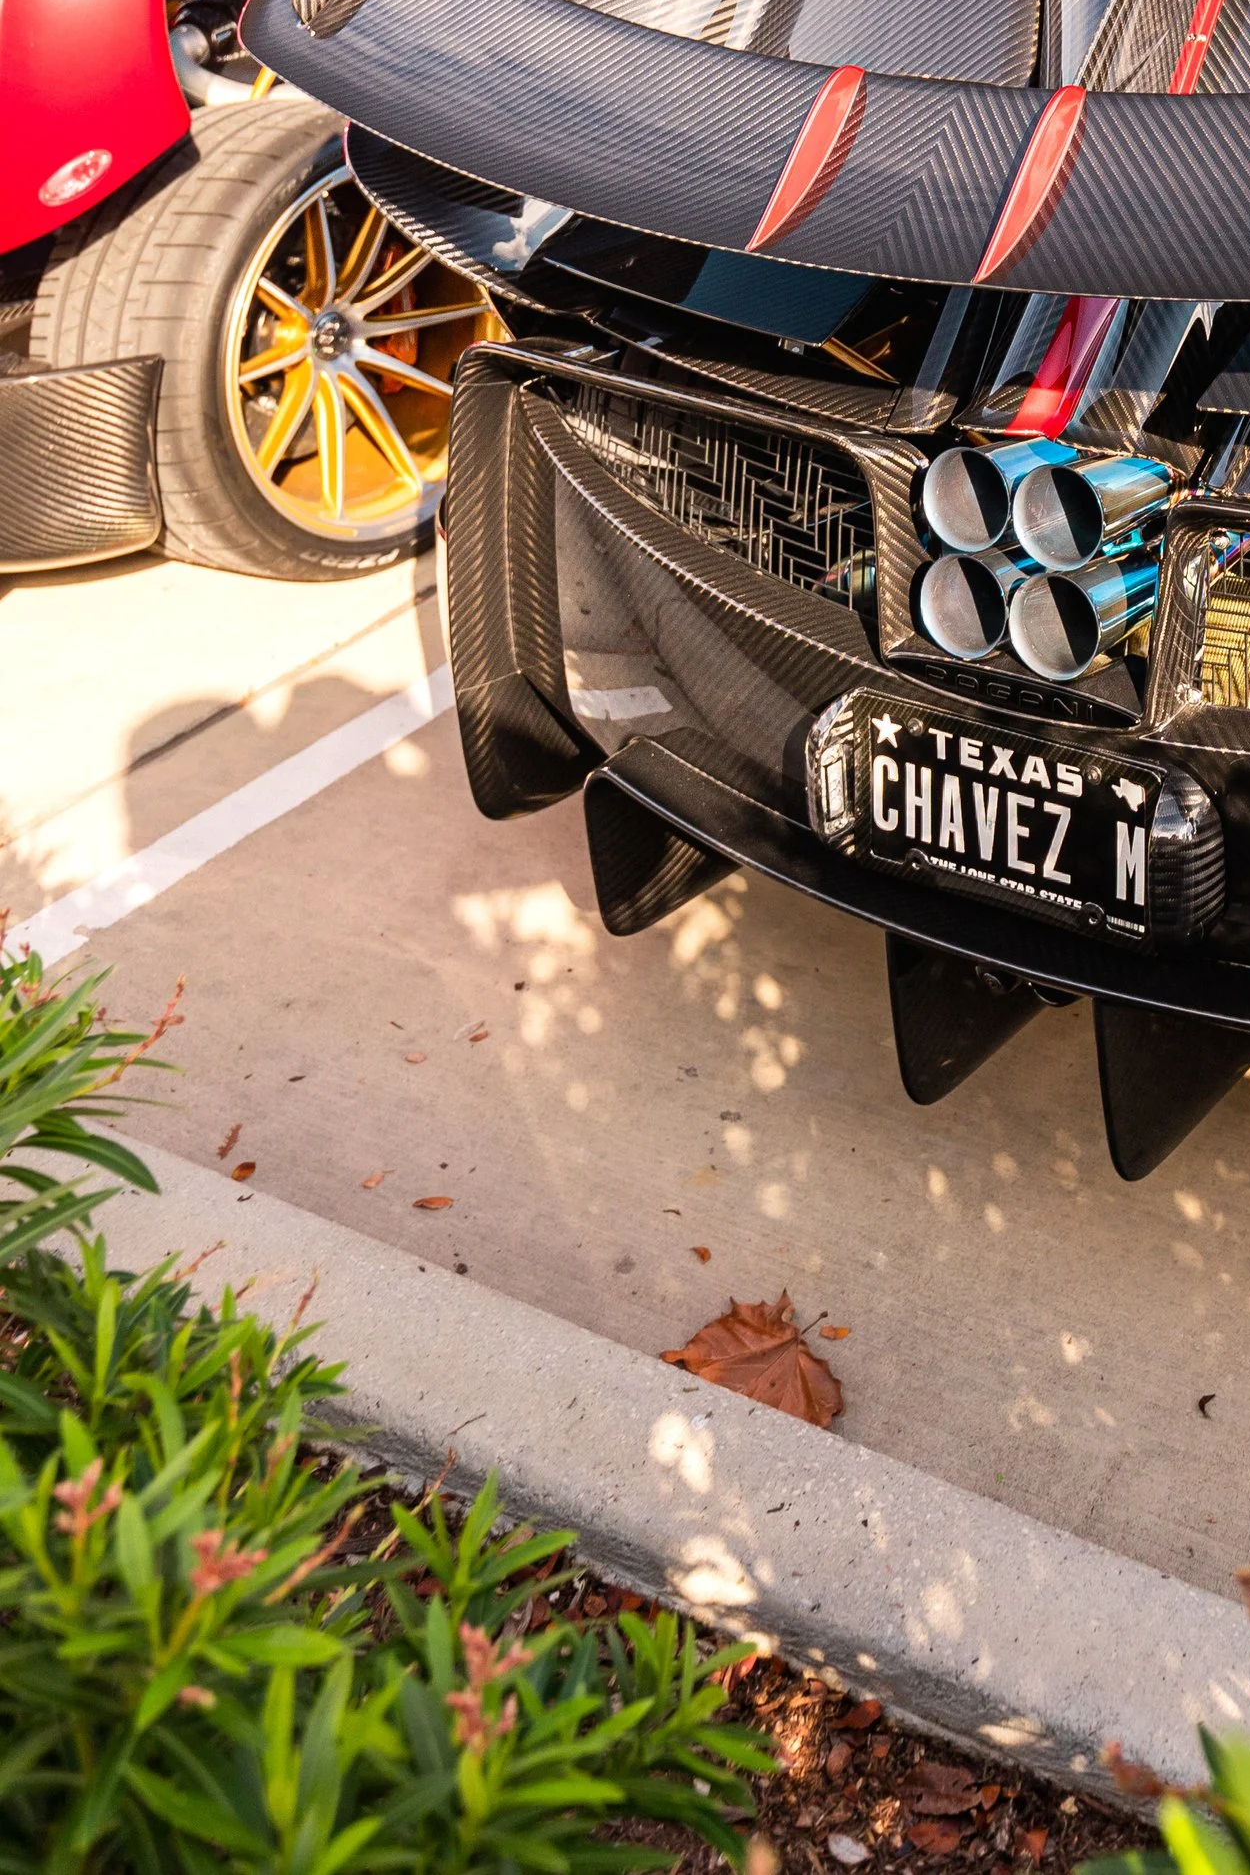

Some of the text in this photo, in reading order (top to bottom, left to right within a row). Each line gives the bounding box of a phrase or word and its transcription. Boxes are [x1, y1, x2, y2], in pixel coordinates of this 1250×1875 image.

[924, 663, 1094, 722] PAGANI
[928, 727, 1083, 797] TEXAS
[872, 754, 1145, 906] CHAVEZ M
